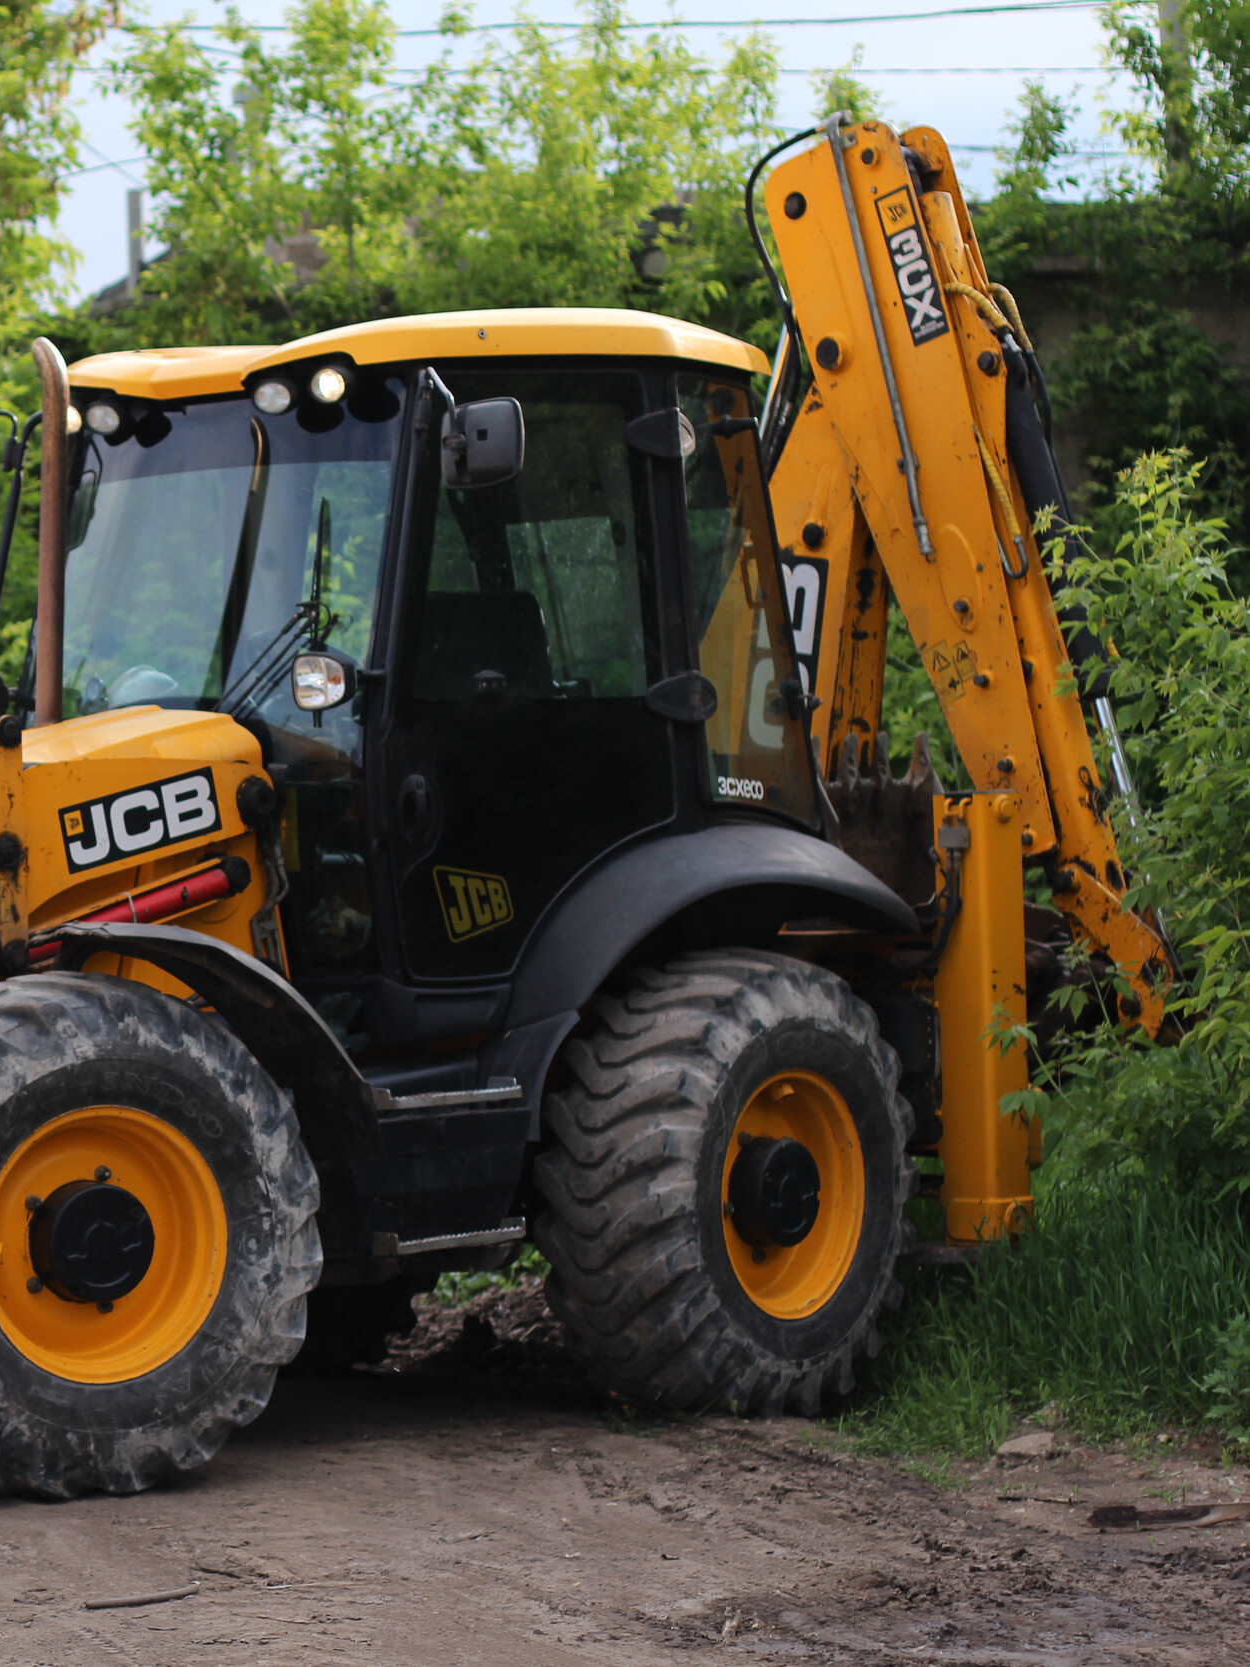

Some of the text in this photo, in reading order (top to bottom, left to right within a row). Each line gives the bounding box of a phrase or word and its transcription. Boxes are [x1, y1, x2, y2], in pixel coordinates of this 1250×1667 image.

[890, 228, 943, 329] 3CX
[69, 775, 217, 866] JCB
[448, 874, 509, 934] JCB
